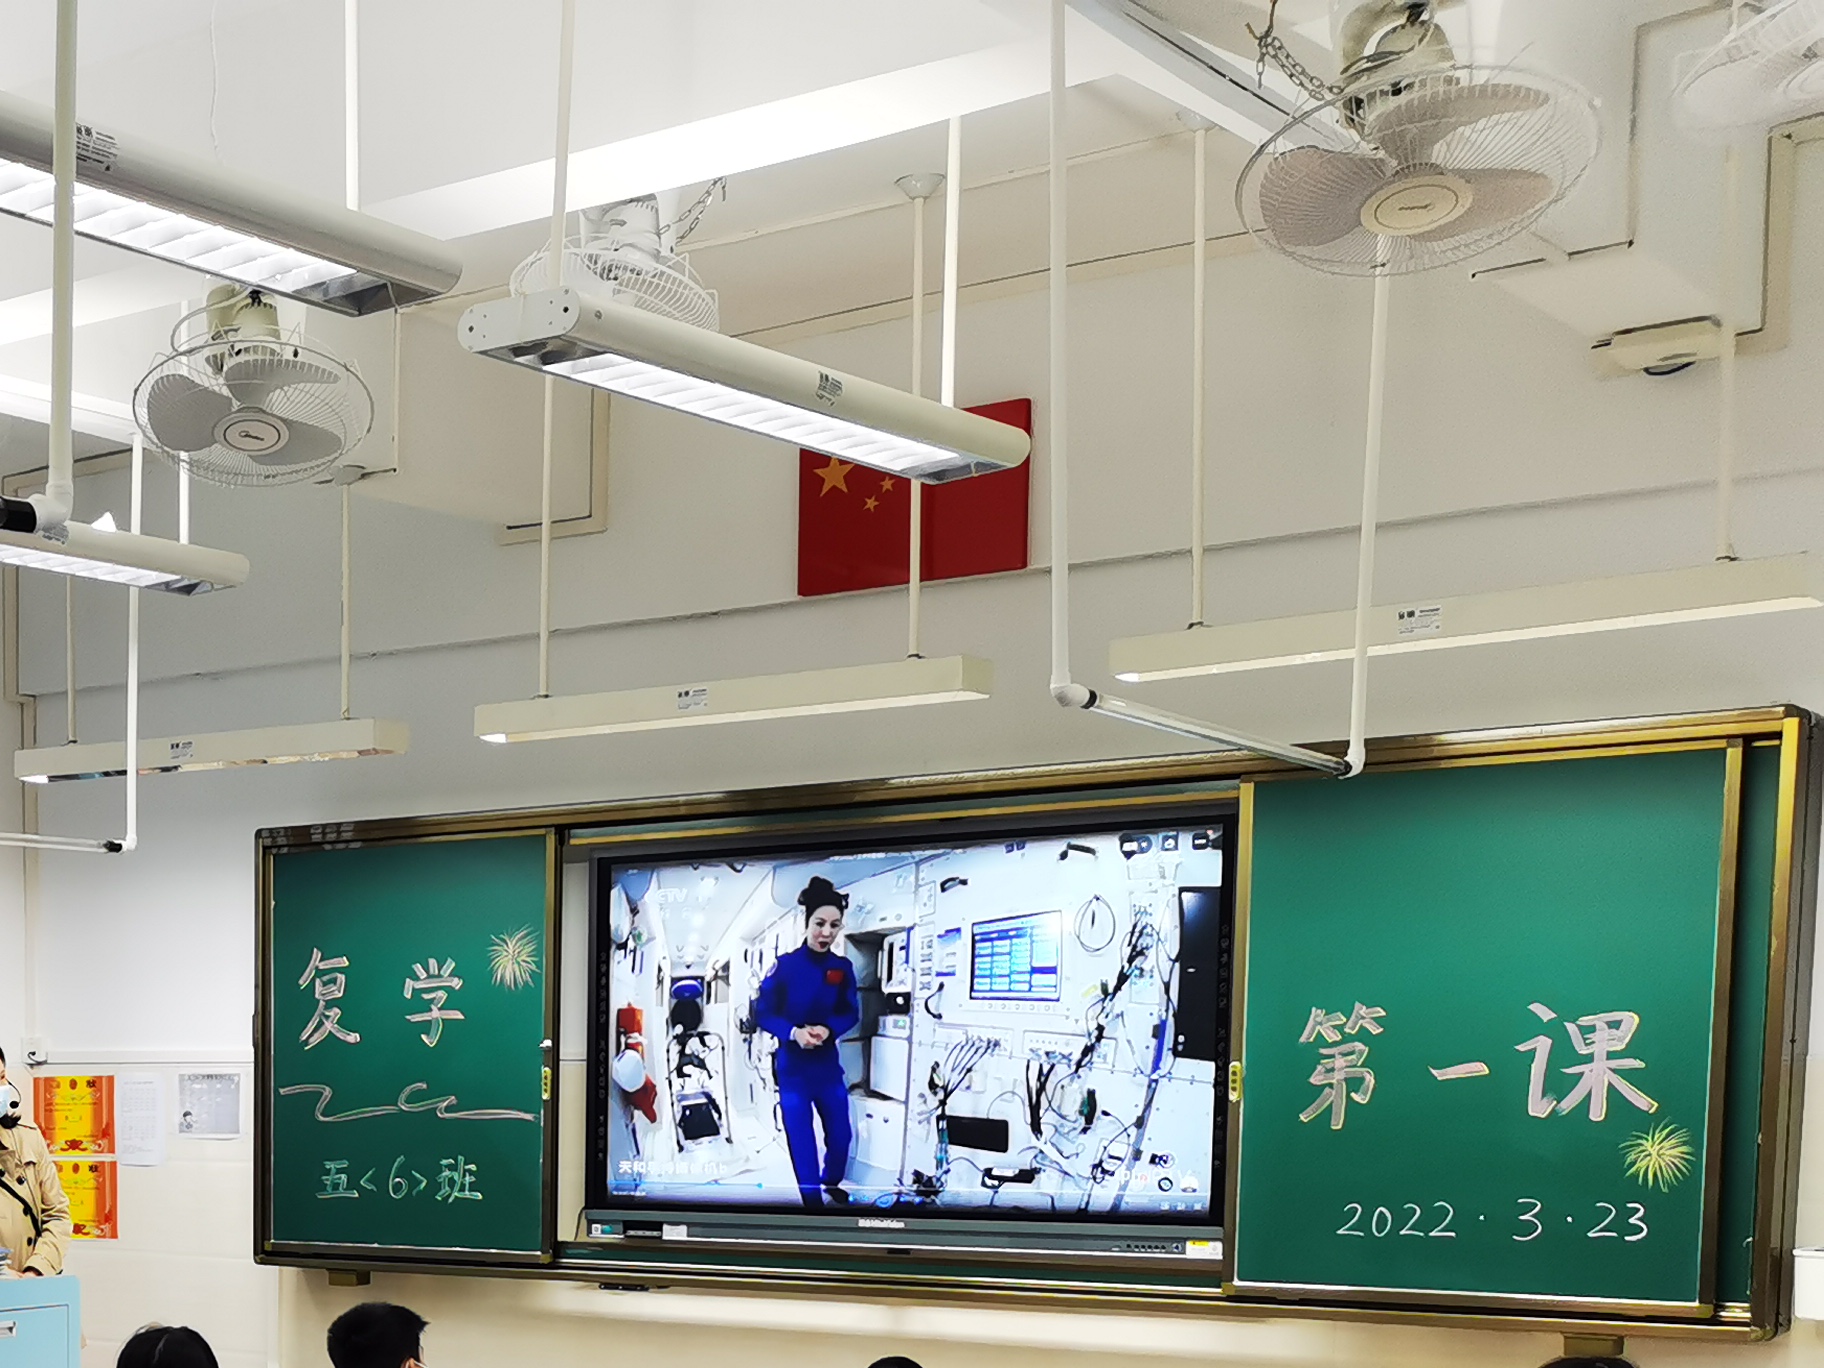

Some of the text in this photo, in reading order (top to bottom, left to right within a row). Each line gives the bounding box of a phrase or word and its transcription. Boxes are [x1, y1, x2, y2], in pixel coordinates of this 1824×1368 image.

[298, 947, 466, 1051] 复学
[1298, 1001, 1658, 1130] 第一课
